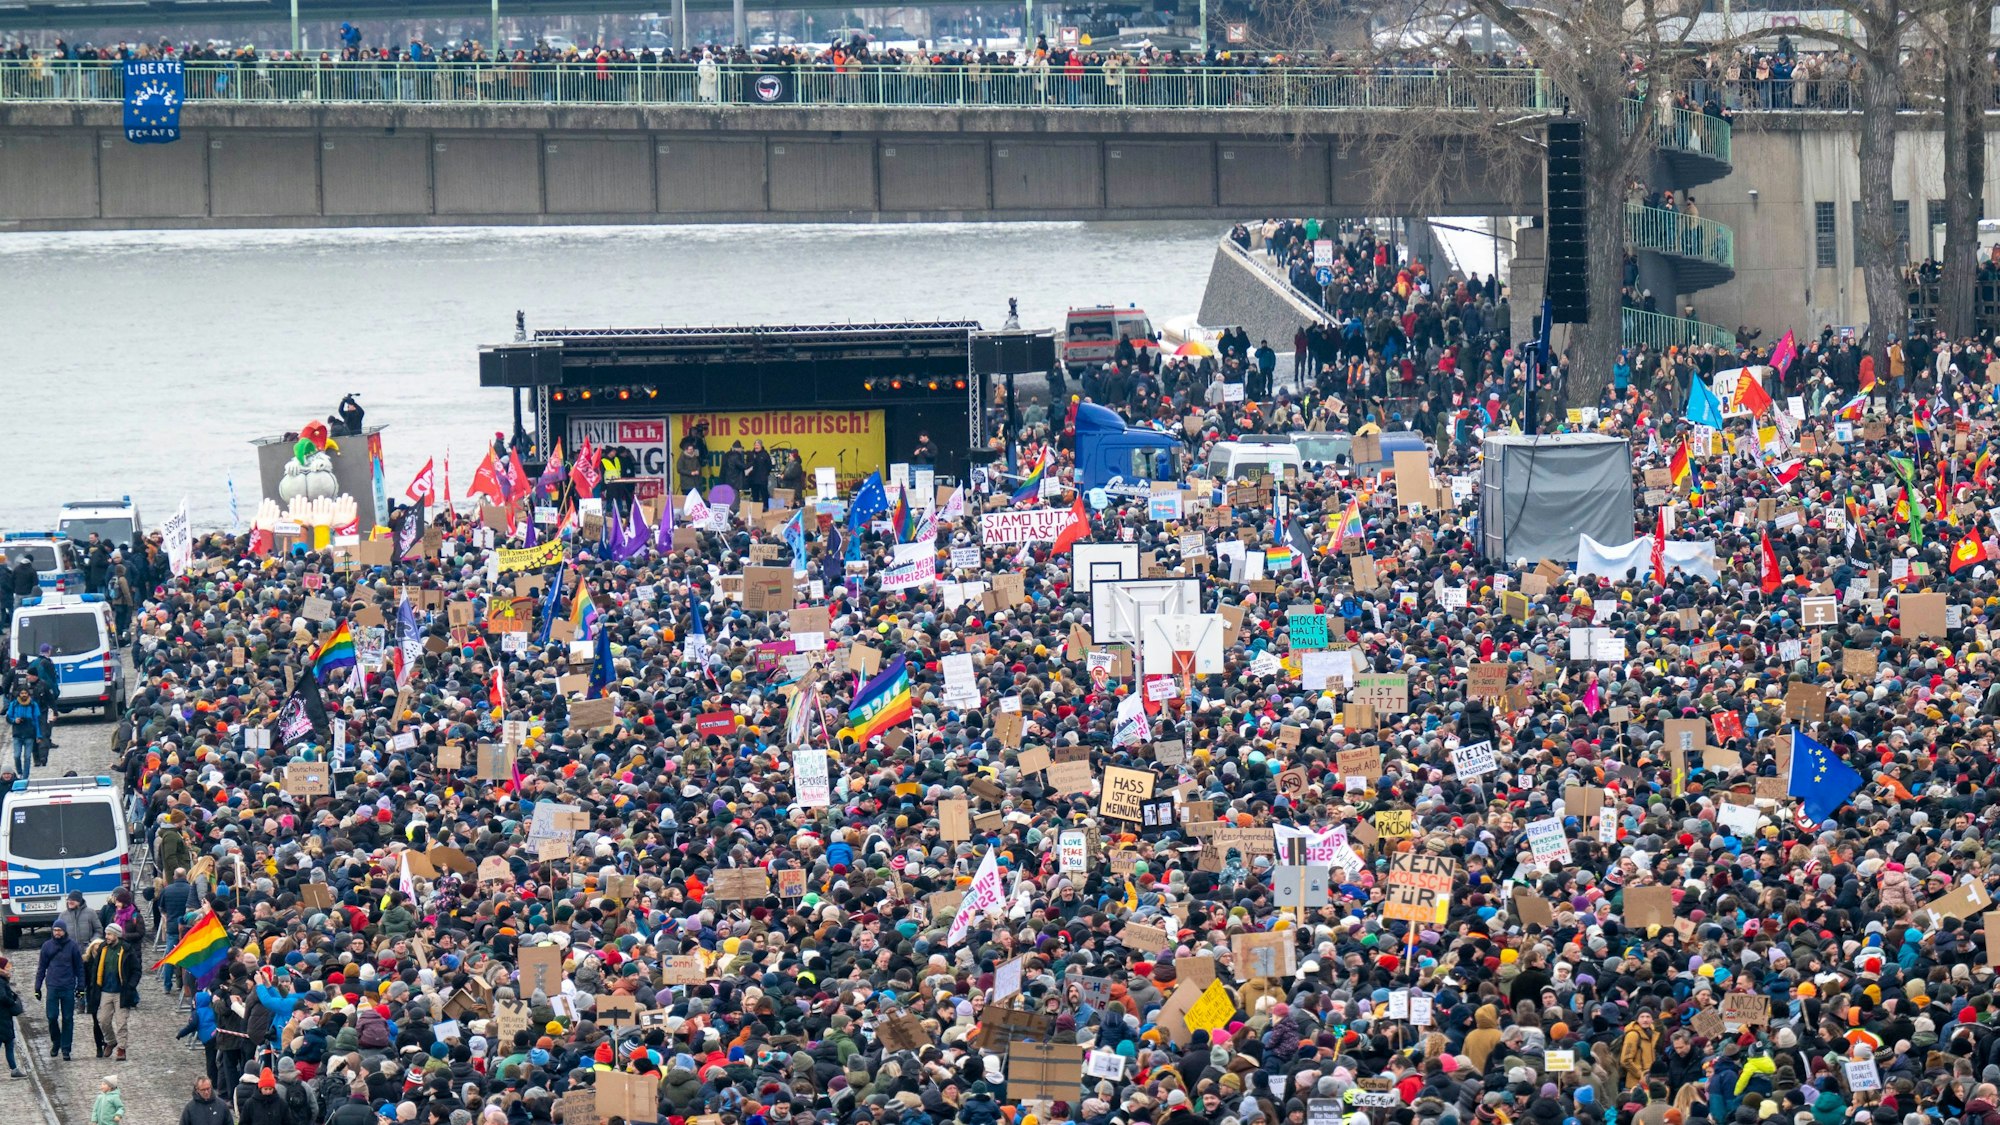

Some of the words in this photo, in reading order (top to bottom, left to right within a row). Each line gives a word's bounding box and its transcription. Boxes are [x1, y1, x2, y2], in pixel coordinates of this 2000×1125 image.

[127, 62, 182, 76] LIBERTE
[738, 411, 870, 436] solidarisch!
[575, 420, 617, 442] ARSCH
[622, 424, 662, 441] huh,
[983, 513, 1031, 529] SIAMO
[1292, 637, 1319, 646] MAUL
[1370, 687, 1392, 696] IST
[1455, 743, 1490, 763] KEIN
[289, 765, 325, 773] Deutschland
[1459, 762, 1494, 778] RASSISMUS
[1113, 776, 1144, 794] HASS
[1112, 791, 1126, 801] IST
[1105, 802, 1142, 819] MEINUNG
[1382, 811, 1403, 822] STOP
[1377, 821, 1411, 837] RACISM
[1527, 822, 1560, 837] FREIHEIT
[1063, 838, 1082, 846] LOVE
[1063, 847, 1083, 856] PEACE
[1062, 857, 1068, 866] &
[1391, 853, 1454, 877] KEIN
[782, 870, 801, 882] LIEBE
[1389, 871, 1451, 892] KÖLSCH
[14, 884, 60, 896] POLIZEI
[784, 883, 803, 896] HASS
[1386, 884, 1435, 908] FÜR
[1384, 902, 1434, 920] NAZIS!
[664, 955, 693, 968] Conni
[1737, 1011, 1758, 1020] RAUS
[1377, 1094, 1395, 1106] NEIN
